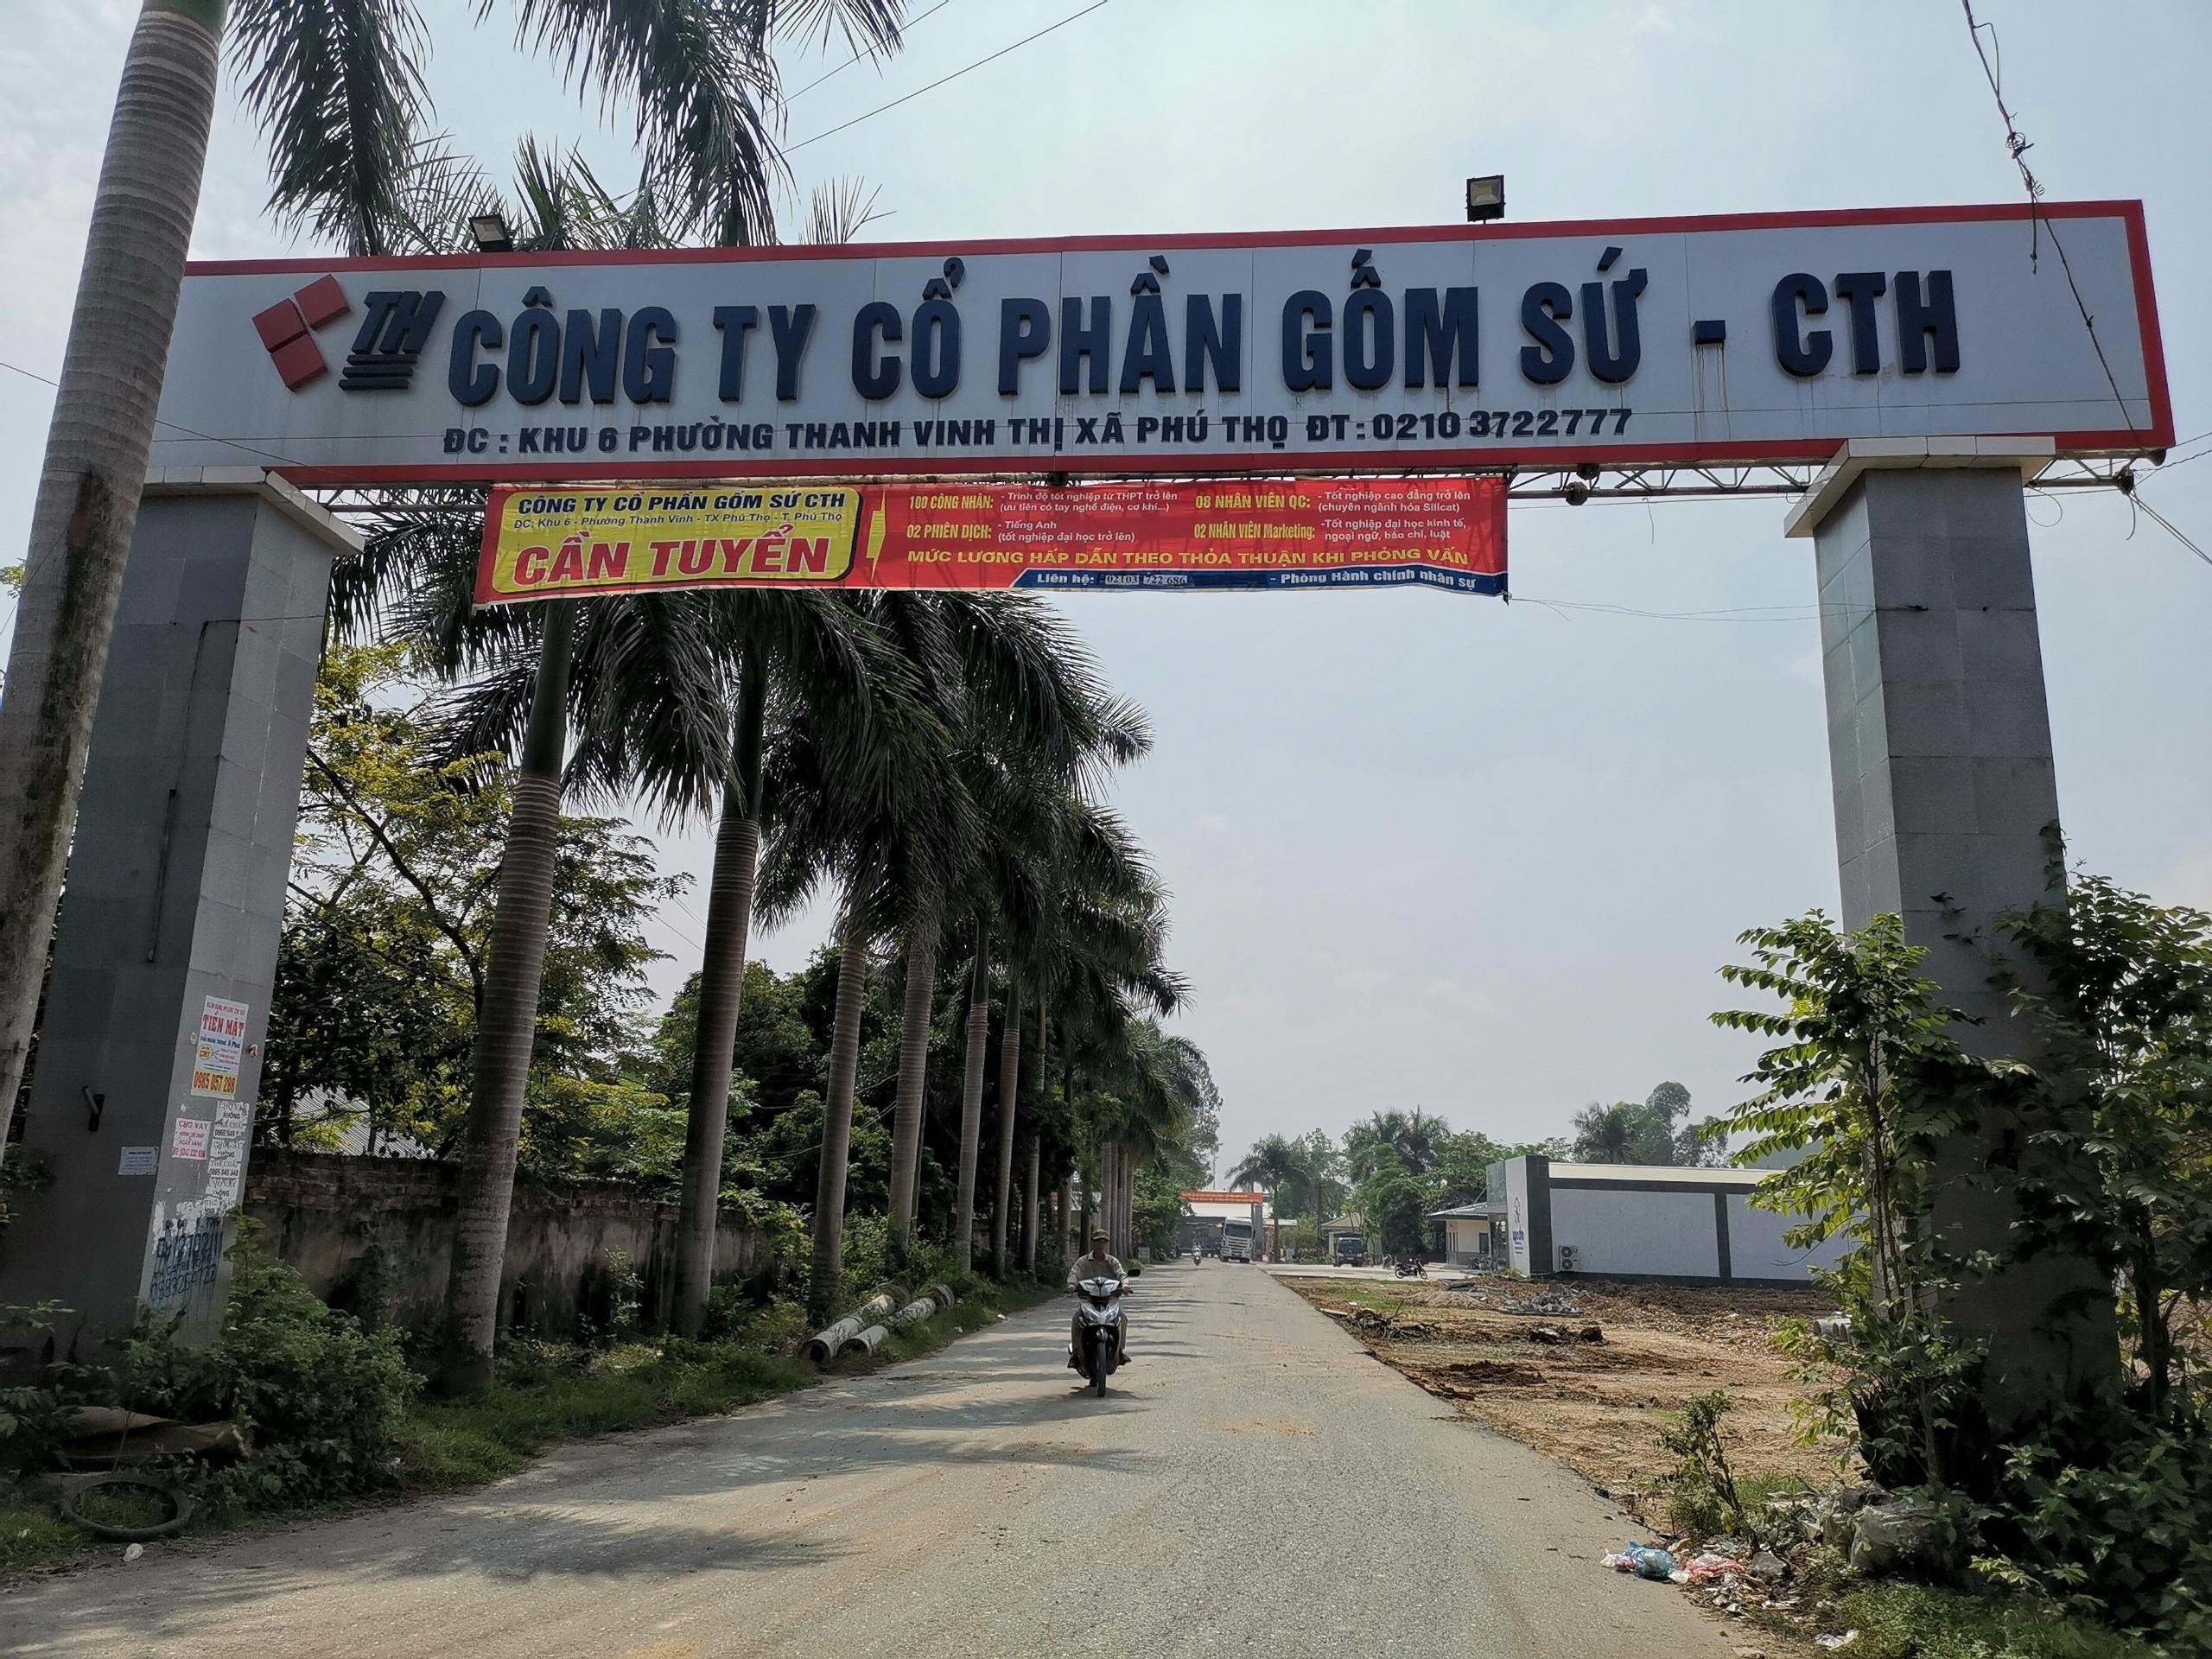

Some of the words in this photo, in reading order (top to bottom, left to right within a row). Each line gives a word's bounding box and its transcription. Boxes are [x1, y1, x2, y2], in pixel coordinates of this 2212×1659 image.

[448, 286, 676, 407] CÔNG
[714, 305, 816, 402] TY
[852, 257, 966, 400] CỔ
[998, 255, 1242, 396] PHẦN
[1282, 249, 1479, 392] GỐM
[1520, 246, 1649, 385] SỨ
[1694, 320, 1726, 345] -
[1771, 270, 1961, 378] CTH
[518, 427, 588, 453] KHU
[598, 428, 619, 453] 6
[628, 415, 773, 452] PHƯỜNG
[786, 421, 900, 449] THANH
[914, 419, 995, 447] VINH
[1008, 417, 1064, 452] THỊ
[1076, 412, 1124, 444] XÃ
[1138, 410, 1208, 443] PHÚ
[1222, 416, 1287, 449] THỌ
[1469, 409, 1632, 439] 3722777
[518, 495, 576, 514] CÔNG
[584, 497, 607, 512] TY
[613, 491, 645, 511] CỔ
[648, 491, 708, 511] PHẦN
[714, 490, 762, 509] GỐM
[769, 490, 801, 508] SỨ
[805, 493, 845, 508] CTH
[909, 495, 928, 509] 100
[931, 493, 958, 509] CÔNG
[961, 493, 994, 509] NHÂN:
[1007, 492, 1033, 500] Trình
[1035, 492, 1048, 501] độ
[1051, 492, 1064, 500] tốt
[1066, 493, 1100, 502] nghiệp
[1146, 490, 1160, 500] trở
[1195, 495, 1211, 508] 08
[1215, 493, 1251, 508] NHÂN
[1255, 493, 1285, 508] VIÊN
[1288, 494, 1311, 510] QC:
[1325, 490, 1342, 499] Tốt
[1344, 491, 1381, 501] nghiệp
[1407, 489, 1433, 500] đẳng
[1436, 490, 1452, 499] trở
[1454, 491, 1470, 499] lên
[1000, 504, 1016, 512] (ưu
[1055, 504, 1070, 512] tay
[1100, 503, 1124, 512] điện,
[1318, 503, 1361, 512] (chuyên
[1363, 503, 1397, 512] ngành
[1400, 503, 1420, 512] hóa
[1423, 503, 1460, 512] Silicat)
[514, 519, 534, 529] ĐC:
[538, 518, 560, 528] Khu
[581, 518, 625, 526] Phường
[629, 516, 664, 524] Thanh
[722, 513, 745, 522] Phú
[750, 513, 770, 523] Thọ
[795, 512, 817, 521] Phú
[821, 512, 842, 522] Thọ
[1005, 520, 1033, 531] Tiếng
[1345, 518, 1382, 529] nghiệp
[1384, 518, 1401, 529] đại
[1404, 518, 1424, 529] học
[1427, 518, 1450, 527] kinh
[1453, 518, 1466, 529] tế,
[907, 524, 921, 538] 02
[924, 522, 958, 538] PHIÊN
[961, 524, 992, 541] DỊCH:
[998, 531, 1015, 543] (tốt
[1019, 532, 1053, 543] nghiệp
[1057, 532, 1072, 543] đại
[1075, 532, 1095, 543] học
[1097, 531, 1113, 541] trở
[1116, 532, 1135, 543] lên)
[1194, 524, 1206, 538] 02
[1209, 521, 1236, 538] NHÂN
[1239, 521, 1262, 538] VIÊN
[1263, 523, 1315, 540] Marketing:
[1325, 531, 1354, 542] ngoại
[1357, 531, 1381, 541] ngữ,
[1384, 530, 1404, 539] báo
[1408, 530, 1427, 539] chí,
[1430, 530, 1451, 540] luật
[512, 530, 632, 586] CẦN
[650, 524, 830, 576] TUYỂN
[907, 549, 951, 563] MỨC
[957, 550, 1024, 563] LƯƠNG
[1029, 548, 1069, 563] HẤP
[1075, 547, 1117, 564] DẪN
[1122, 552, 1173, 564] THEO
[1179, 547, 1231, 564] THỎA
[1237, 550, 1306, 567] THUẬN
[1313, 551, 1344, 563] KHI
[1351, 546, 1421, 562] PHỎNG
[1427, 546, 1469, 565] VẤN
[1037, 573, 1067, 583] Liên
[1072, 574, 1094, 585] hệ:
[1281, 574, 1326, 586] Phòng
[1332, 570, 1369, 582] Hành
[1374, 569, 1415, 582] chính
[1420, 570, 1454, 586] nhân
[1458, 577, 1476, 591] sự
